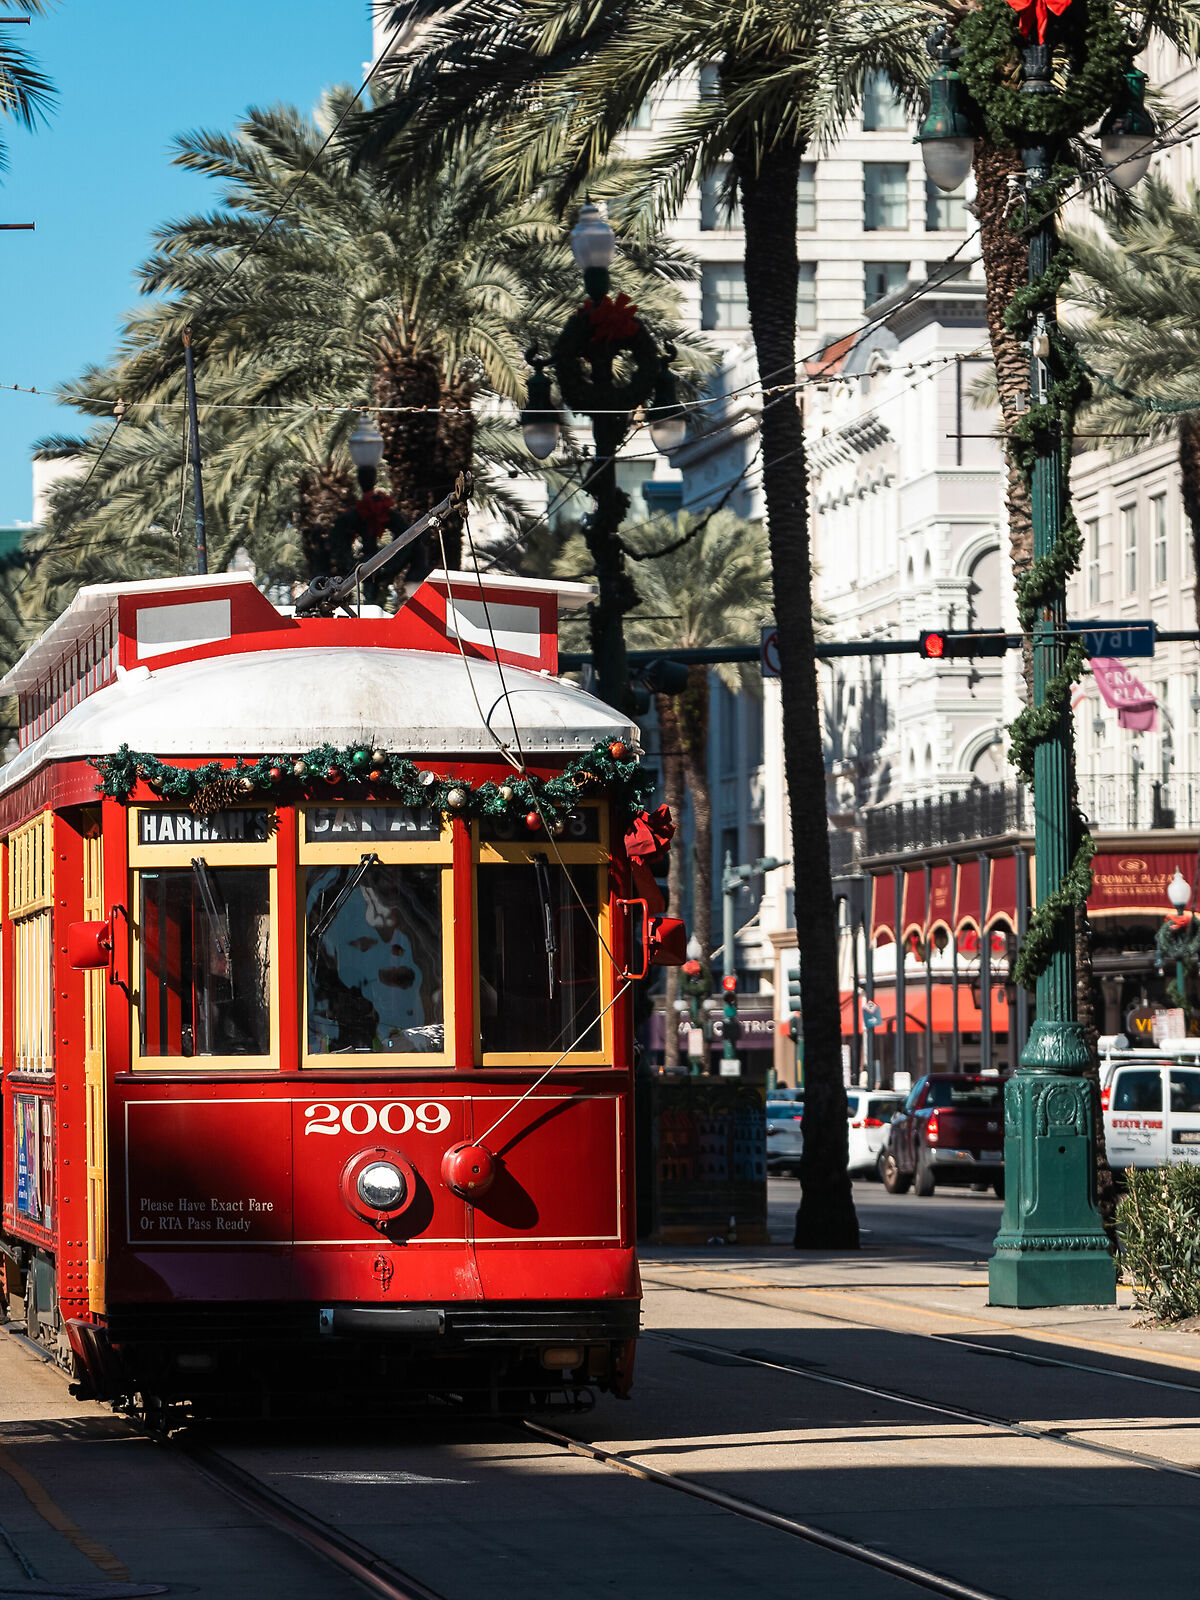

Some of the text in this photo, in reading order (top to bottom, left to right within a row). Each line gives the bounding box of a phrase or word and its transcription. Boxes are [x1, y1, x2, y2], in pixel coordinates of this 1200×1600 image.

[1083, 624, 1133, 655] yal
[1094, 873, 1174, 885] CROWNE PLAZA
[304, 1102, 451, 1136] 2009
[1112, 1119, 1163, 1129] STATE FIRE
[140, 1198, 274, 1212] Please Have Exact Fare
[140, 1216, 251, 1232] Or RTA Pass Ready
